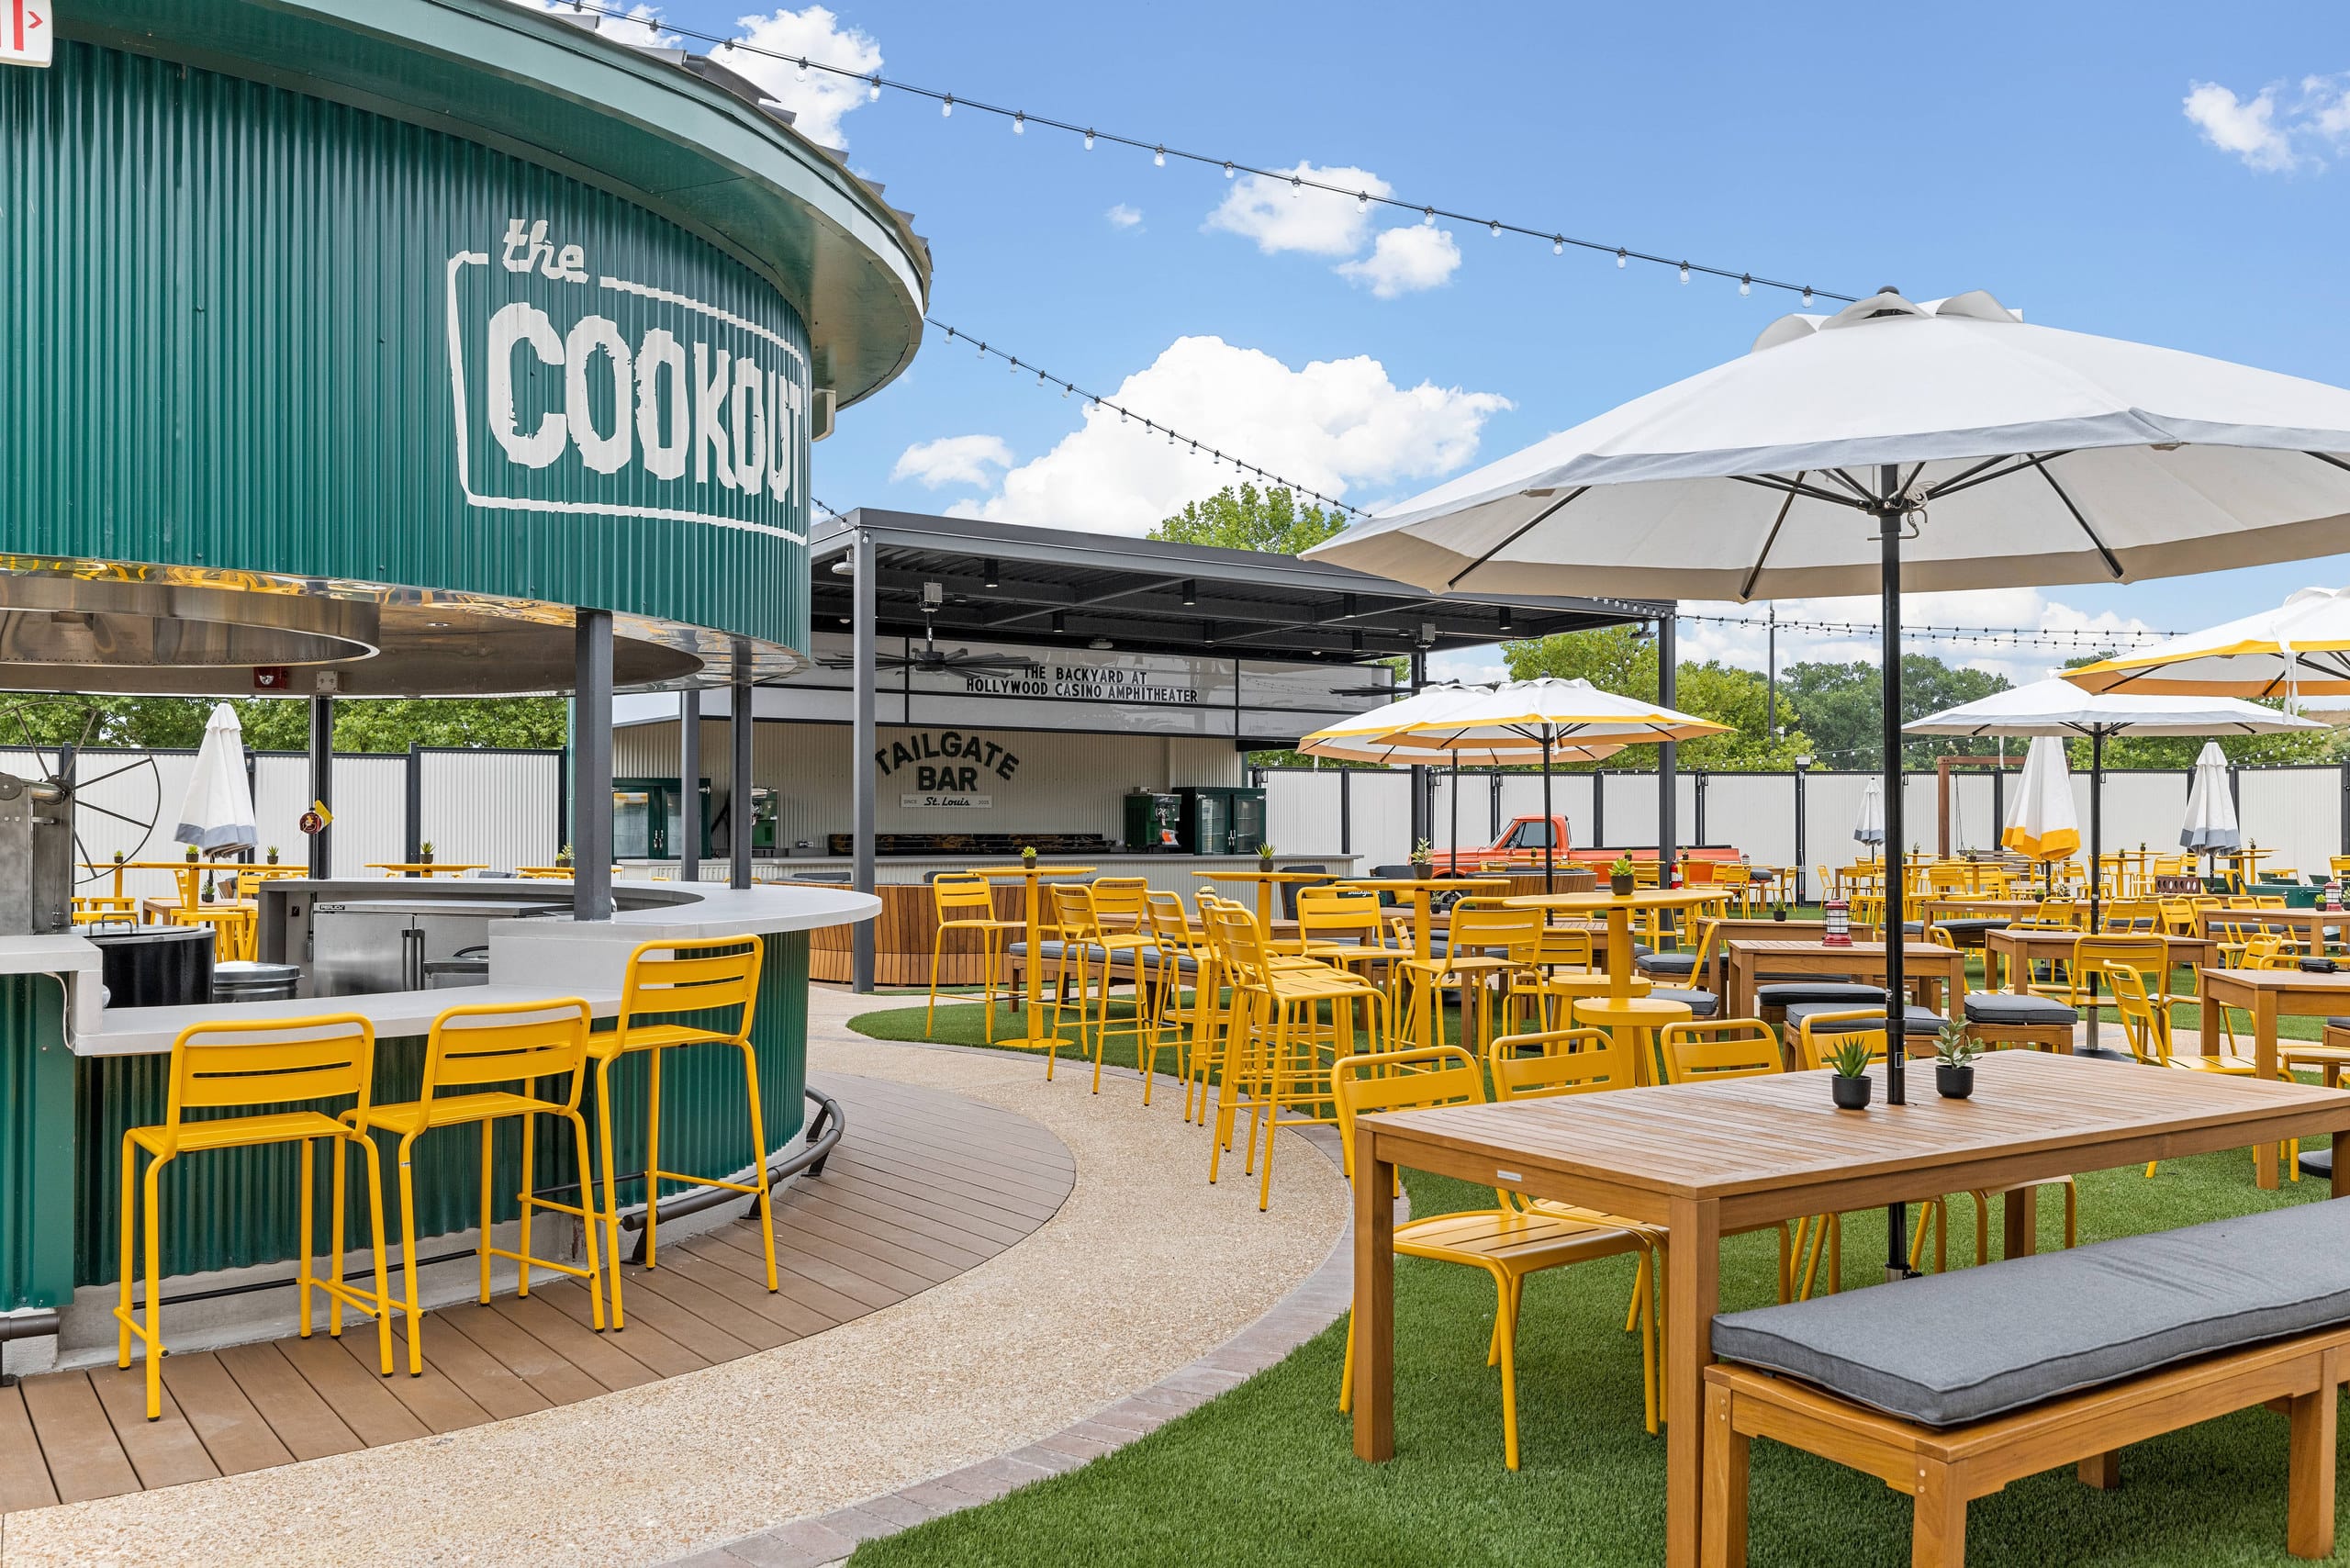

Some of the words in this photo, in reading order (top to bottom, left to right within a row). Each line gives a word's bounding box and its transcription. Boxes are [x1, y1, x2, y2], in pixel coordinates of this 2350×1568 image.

[503, 218, 588, 283] the
[488, 302, 801, 508] COOKOUT
[1024, 665, 1046, 679] THE
[1056, 667, 1124, 683] BACKYARD
[1132, 671, 1147, 685] AT
[967, 678, 1047, 696] HOLLYWOOD
[1055, 683, 1102, 698] CASINO
[1108, 685, 1197, 703] AMPHITHEATER
[874, 731, 1020, 780] TAILGATE
[918, 766, 978, 791] BAR
[923, 796, 941, 806] St.
[942, 796, 970, 806] Louis
